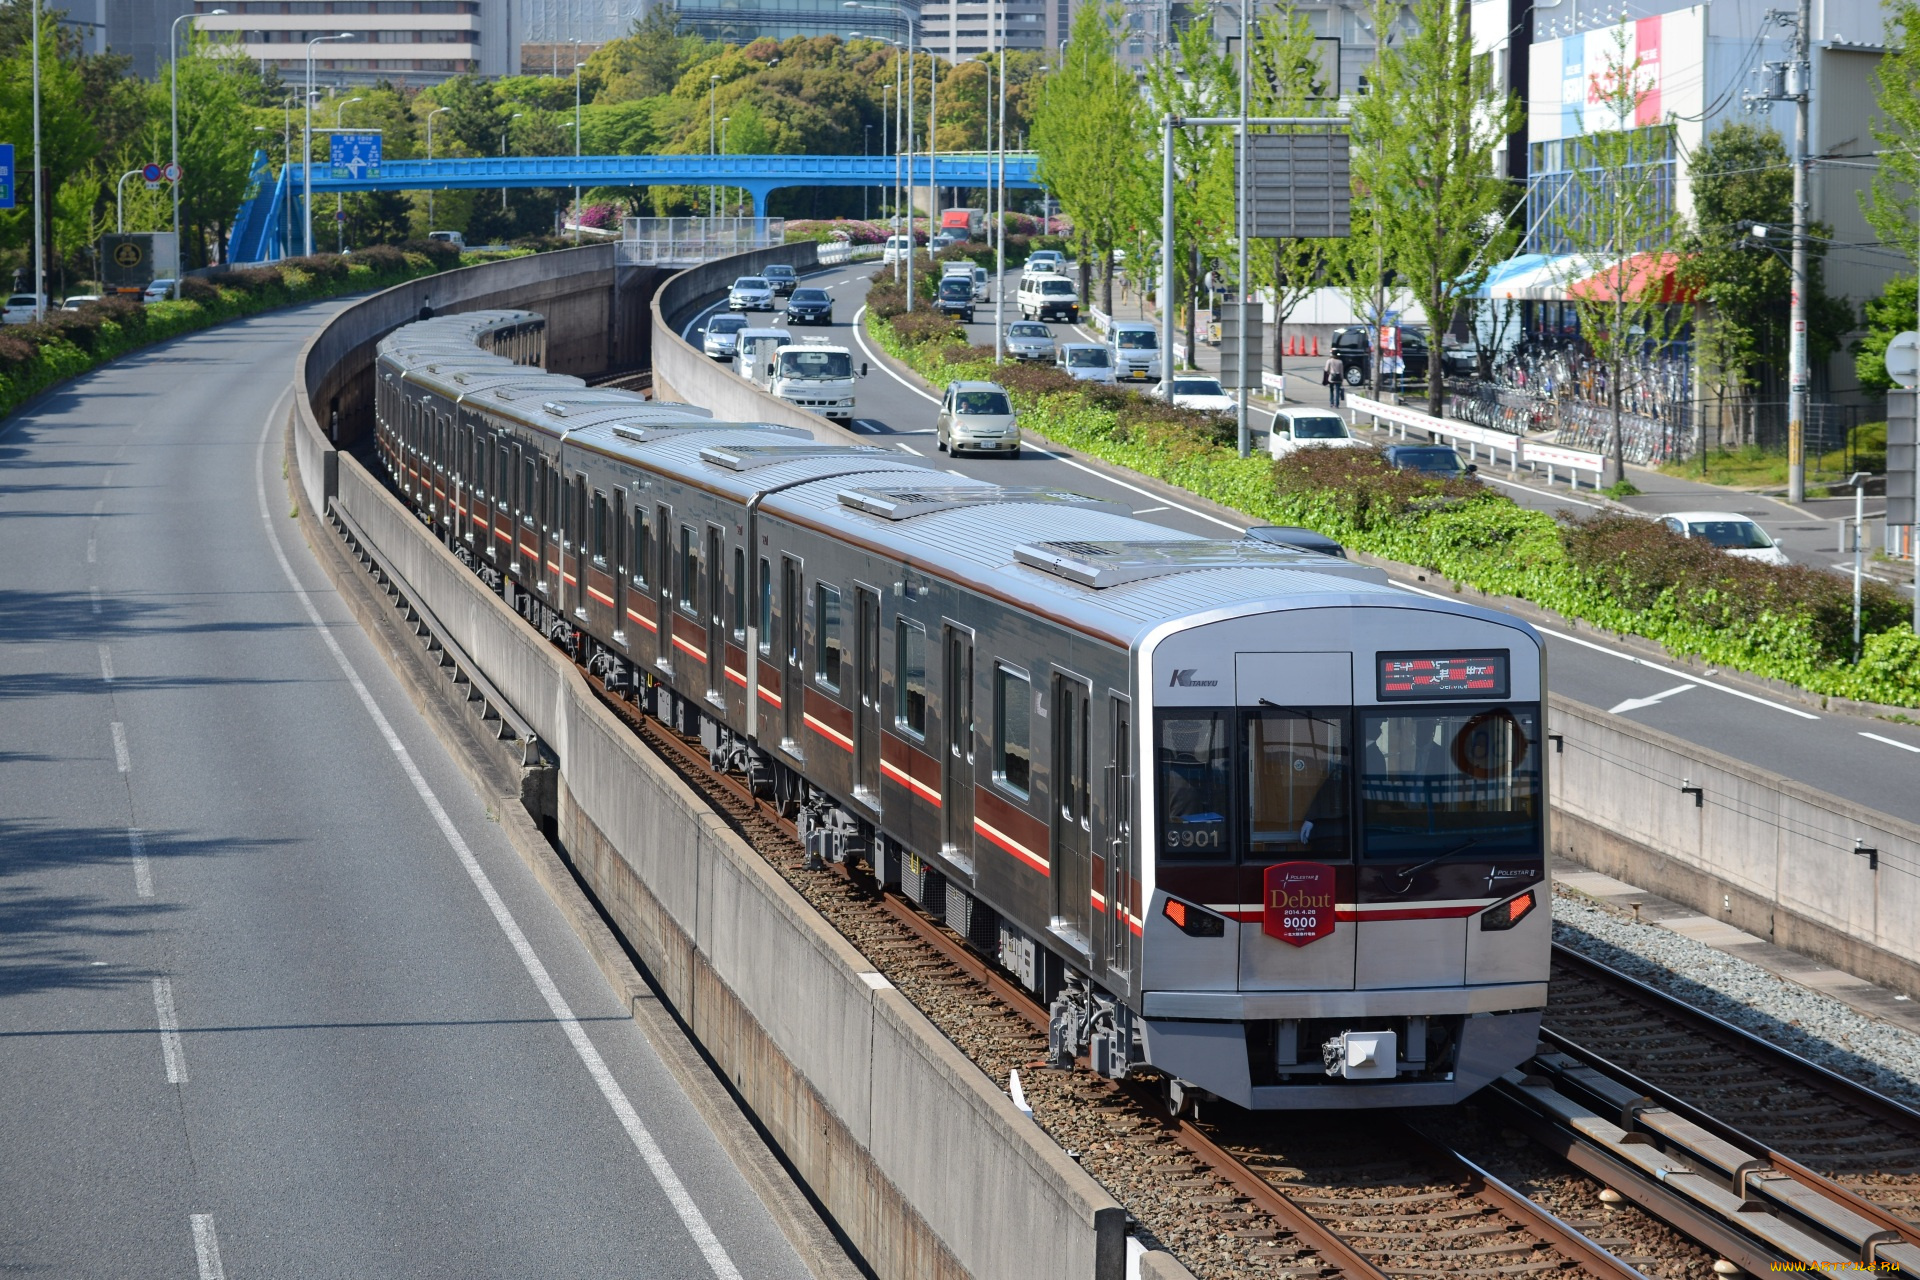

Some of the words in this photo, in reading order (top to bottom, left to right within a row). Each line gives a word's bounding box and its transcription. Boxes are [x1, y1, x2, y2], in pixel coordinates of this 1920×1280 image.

[1167, 830, 1218, 848] 9901
[1270, 889, 1331, 908] Debut
[1284, 917, 1316, 928] 9000
